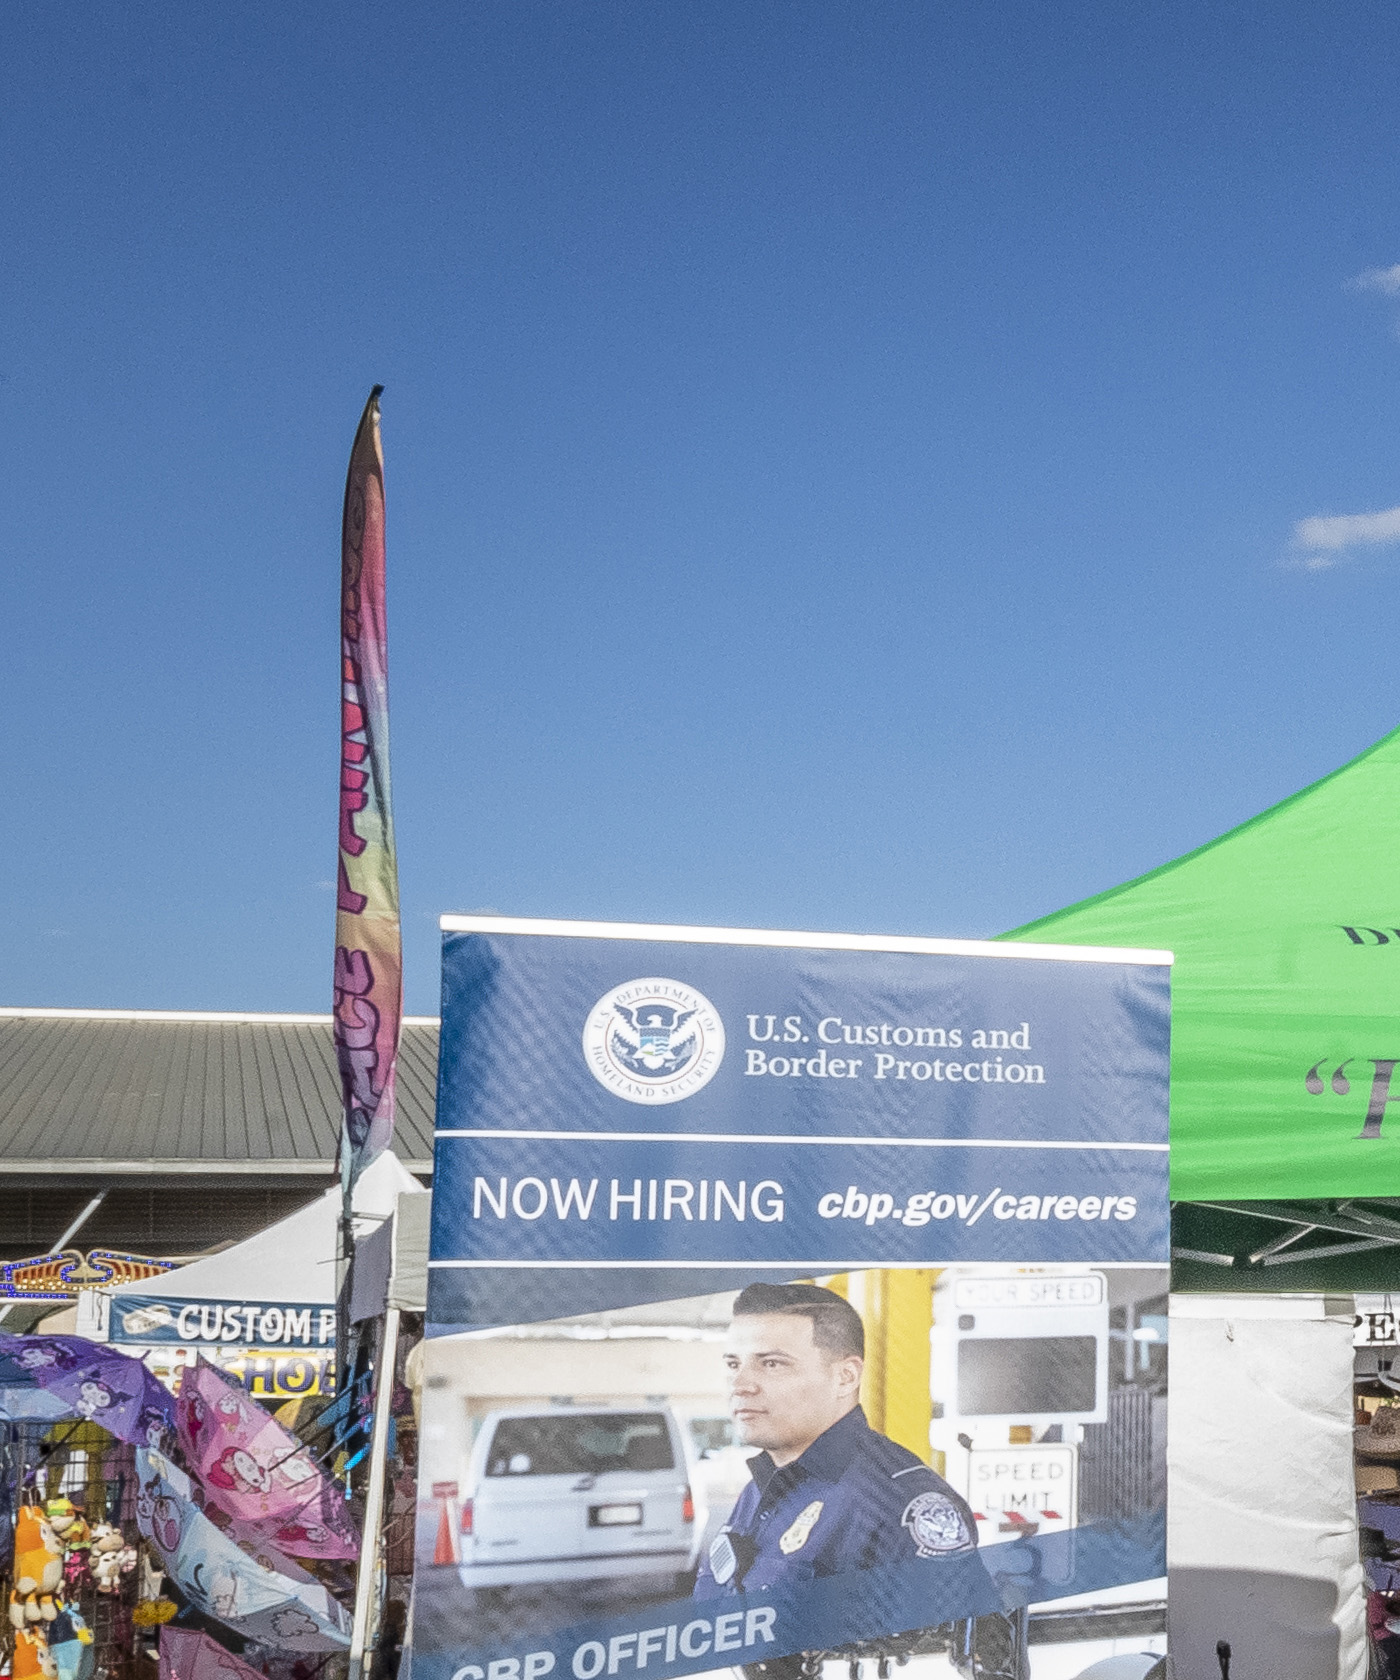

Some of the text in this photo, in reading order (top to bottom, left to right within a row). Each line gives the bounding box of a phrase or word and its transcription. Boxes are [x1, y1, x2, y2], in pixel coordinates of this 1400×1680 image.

[747, 1016, 1030, 1049] U.S. Customs and
[745, 1050, 1046, 1084] Border Protection
[473, 1178, 1136, 1227] NOW HIRING cbp.gov/careers
[176, 1304, 312, 1344] CUSTOM
[978, 1462, 1064, 1481] SPEED
[986, 1491, 1052, 1510] LIMIT
[572, 1607, 777, 1679] OFFICER
